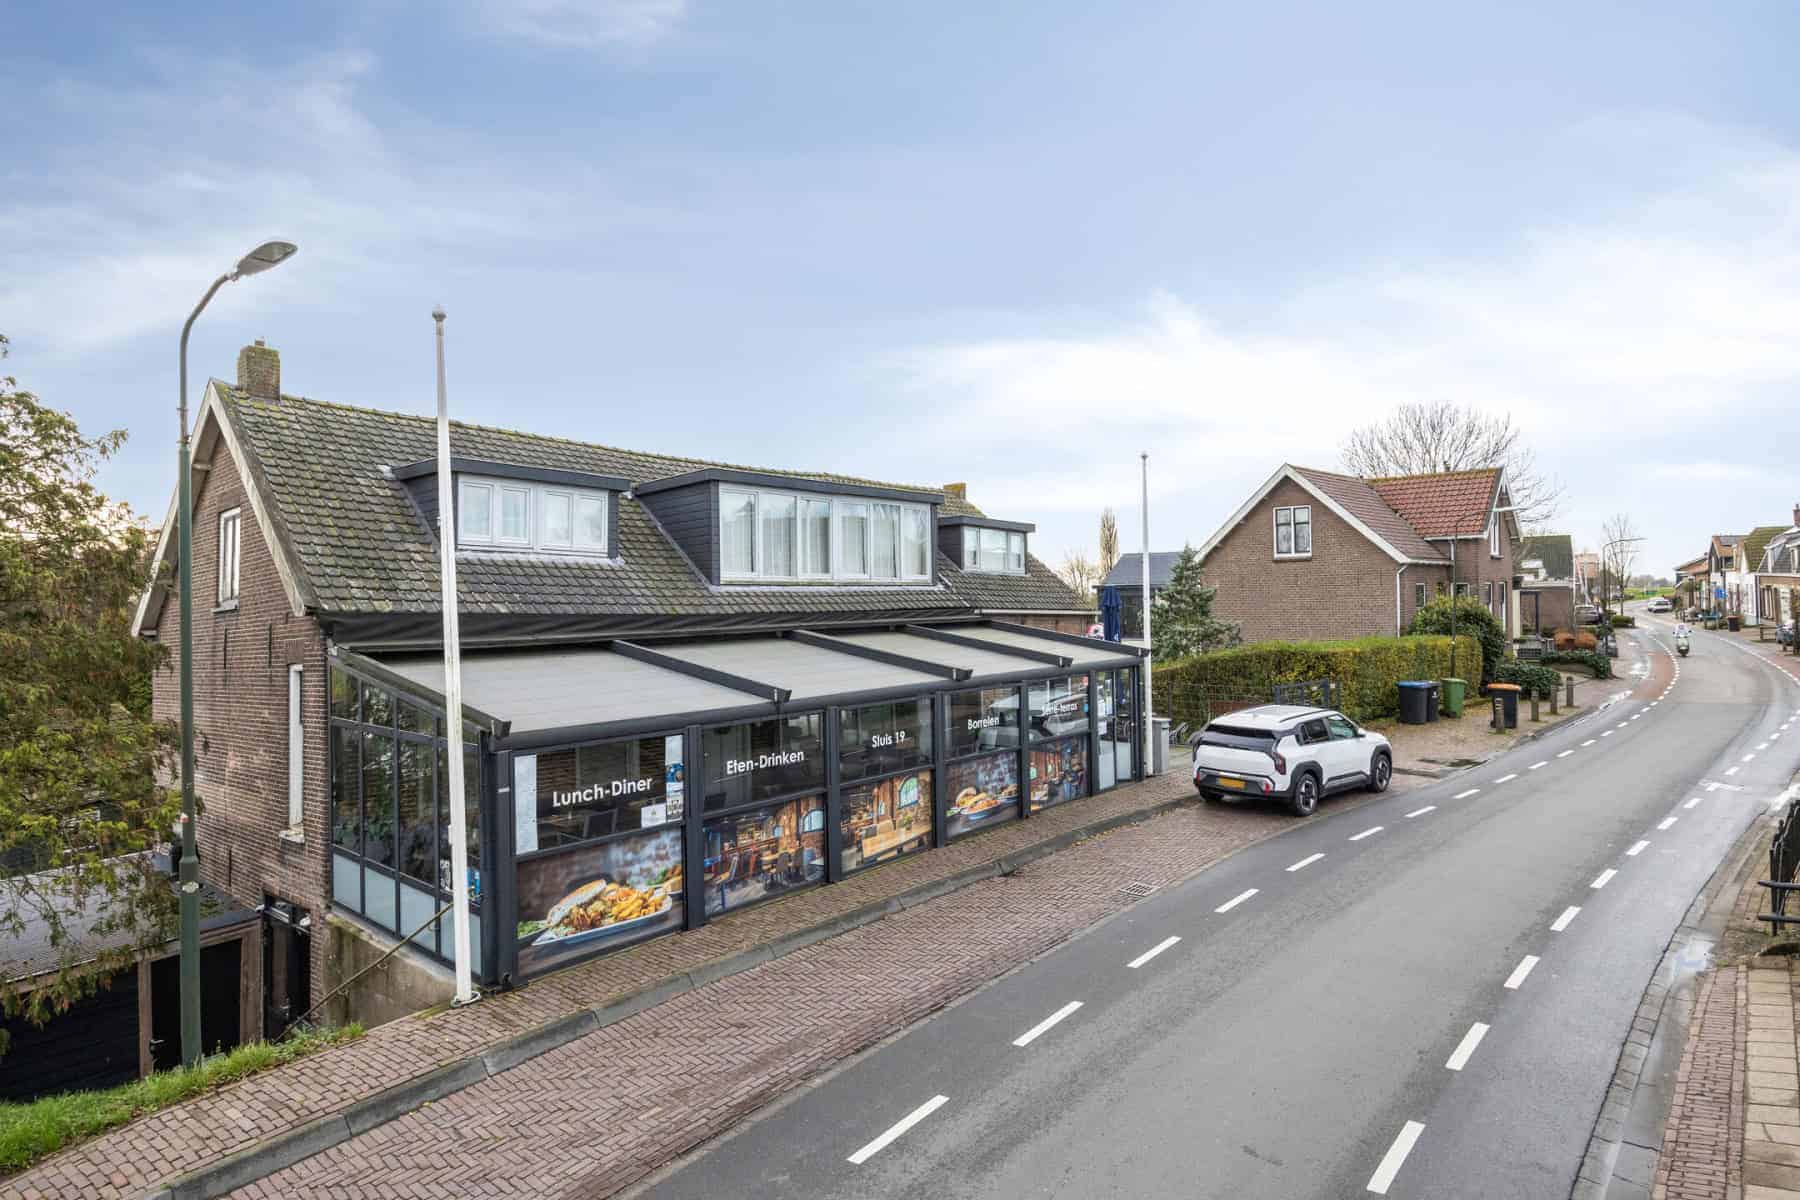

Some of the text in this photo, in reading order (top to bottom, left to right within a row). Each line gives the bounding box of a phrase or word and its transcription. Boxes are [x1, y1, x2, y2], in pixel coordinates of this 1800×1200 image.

[967, 716, 1000, 730] Borrelen
[872, 730, 906, 748] Sluis 19
[726, 751, 805, 775] Eten-Drinken
[553, 777, 653, 807] Lunch-Diner
